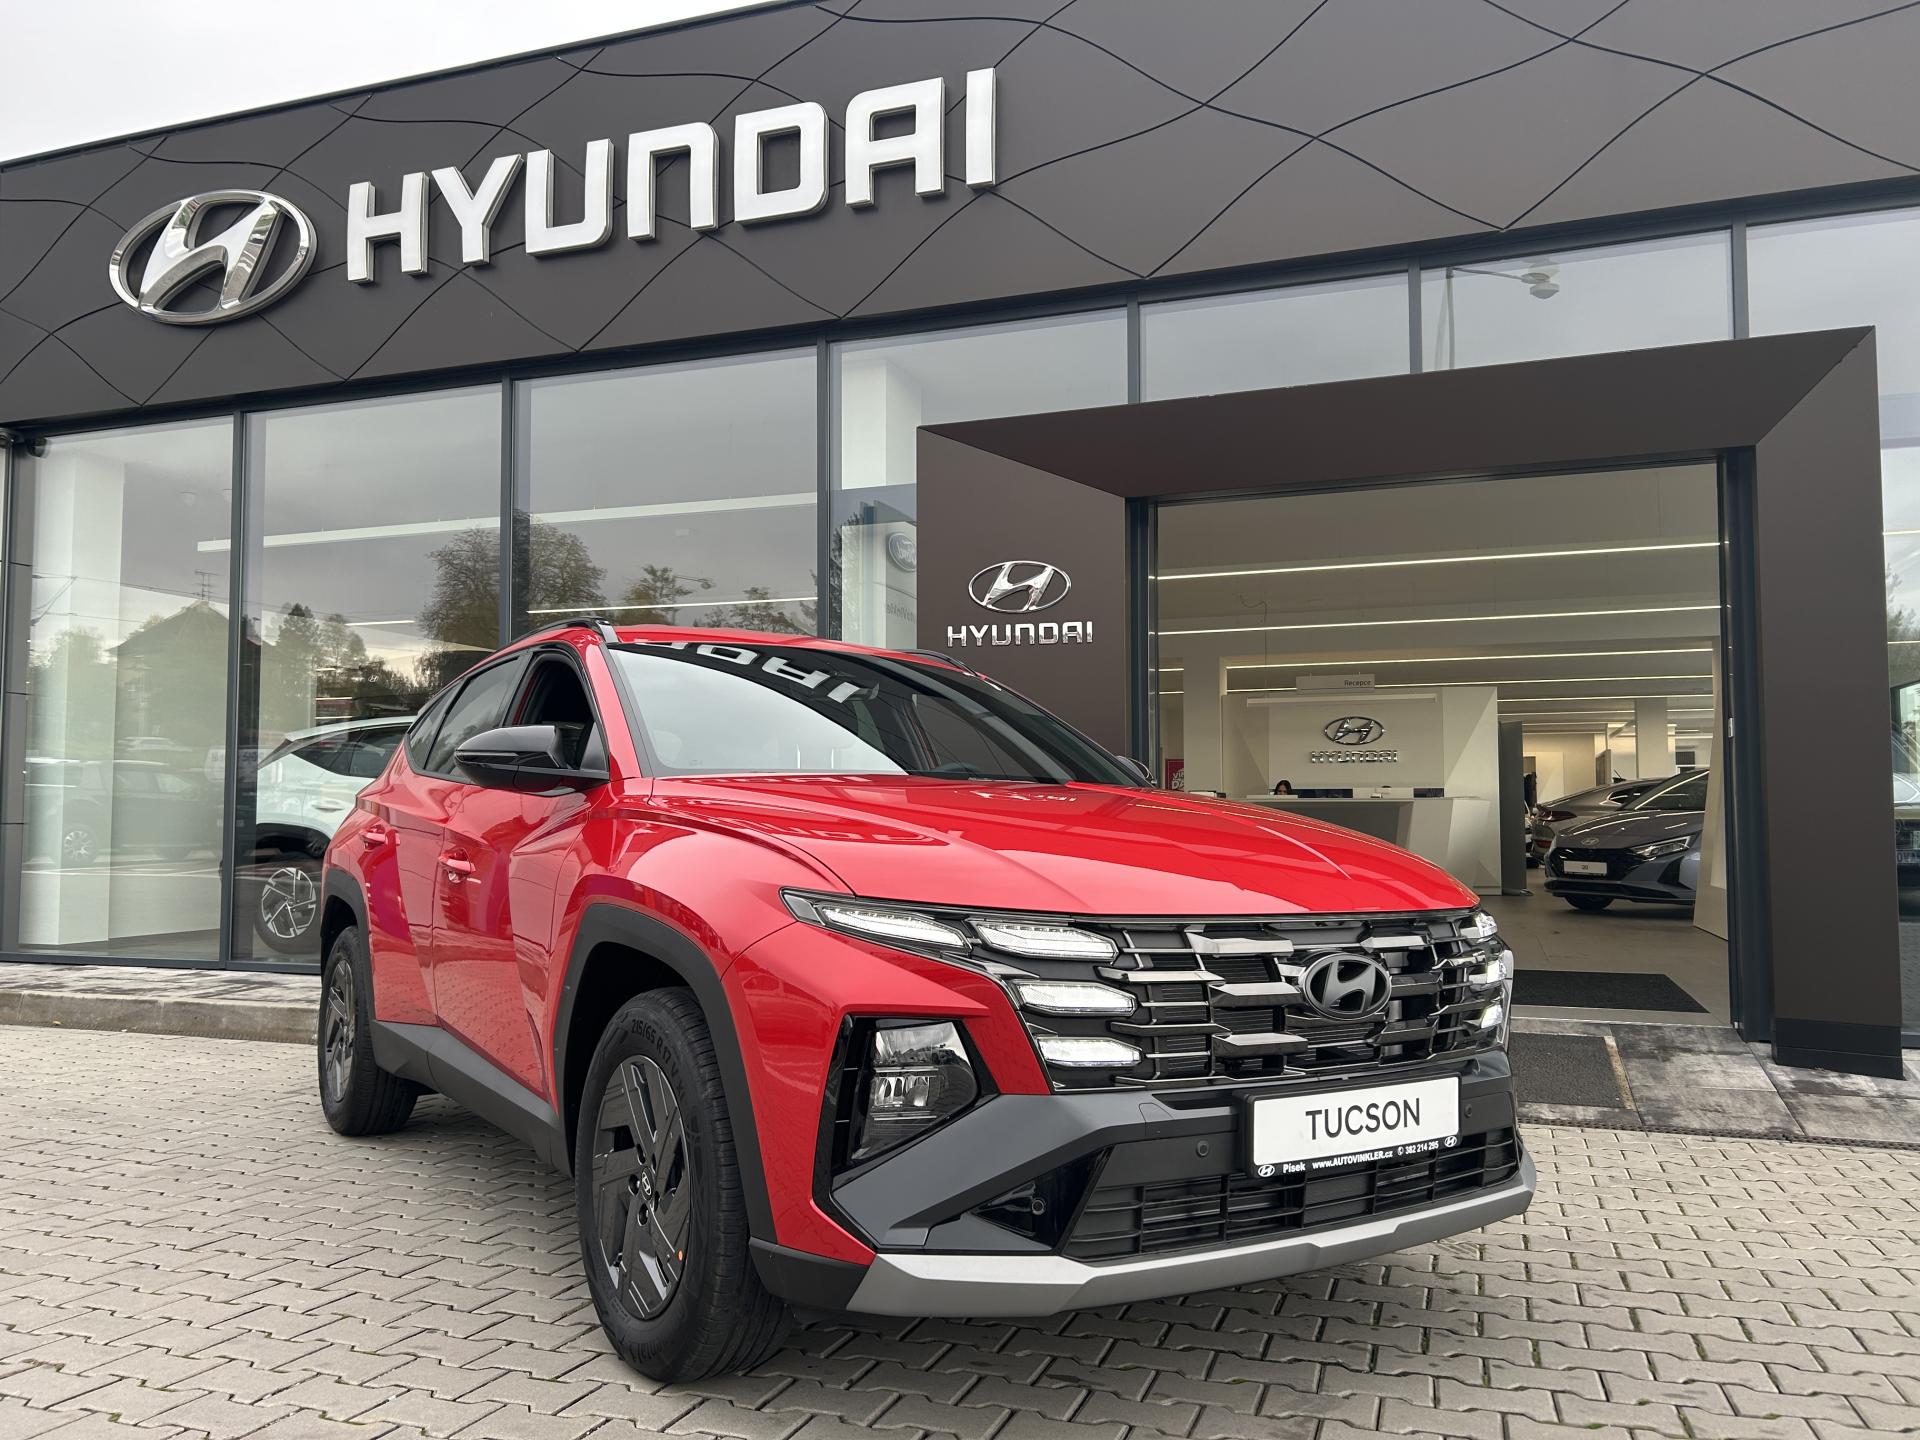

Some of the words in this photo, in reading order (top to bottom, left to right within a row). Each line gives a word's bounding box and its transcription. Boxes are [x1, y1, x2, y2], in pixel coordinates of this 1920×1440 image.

[347, 67, 998, 284] HYUNDAI
[946, 621, 1093, 648] HYUNDAI
[1343, 679, 1372, 688] Recepce
[1311, 750, 1398, 763] HYUNDAI
[1305, 1097, 1420, 1140] TUCSON
[1312, 1151, 1394, 1169] www.AUTOVINKLER.cz
[1405, 1144, 1416, 1154] 382
[1416, 1142, 1428, 1153] 214
